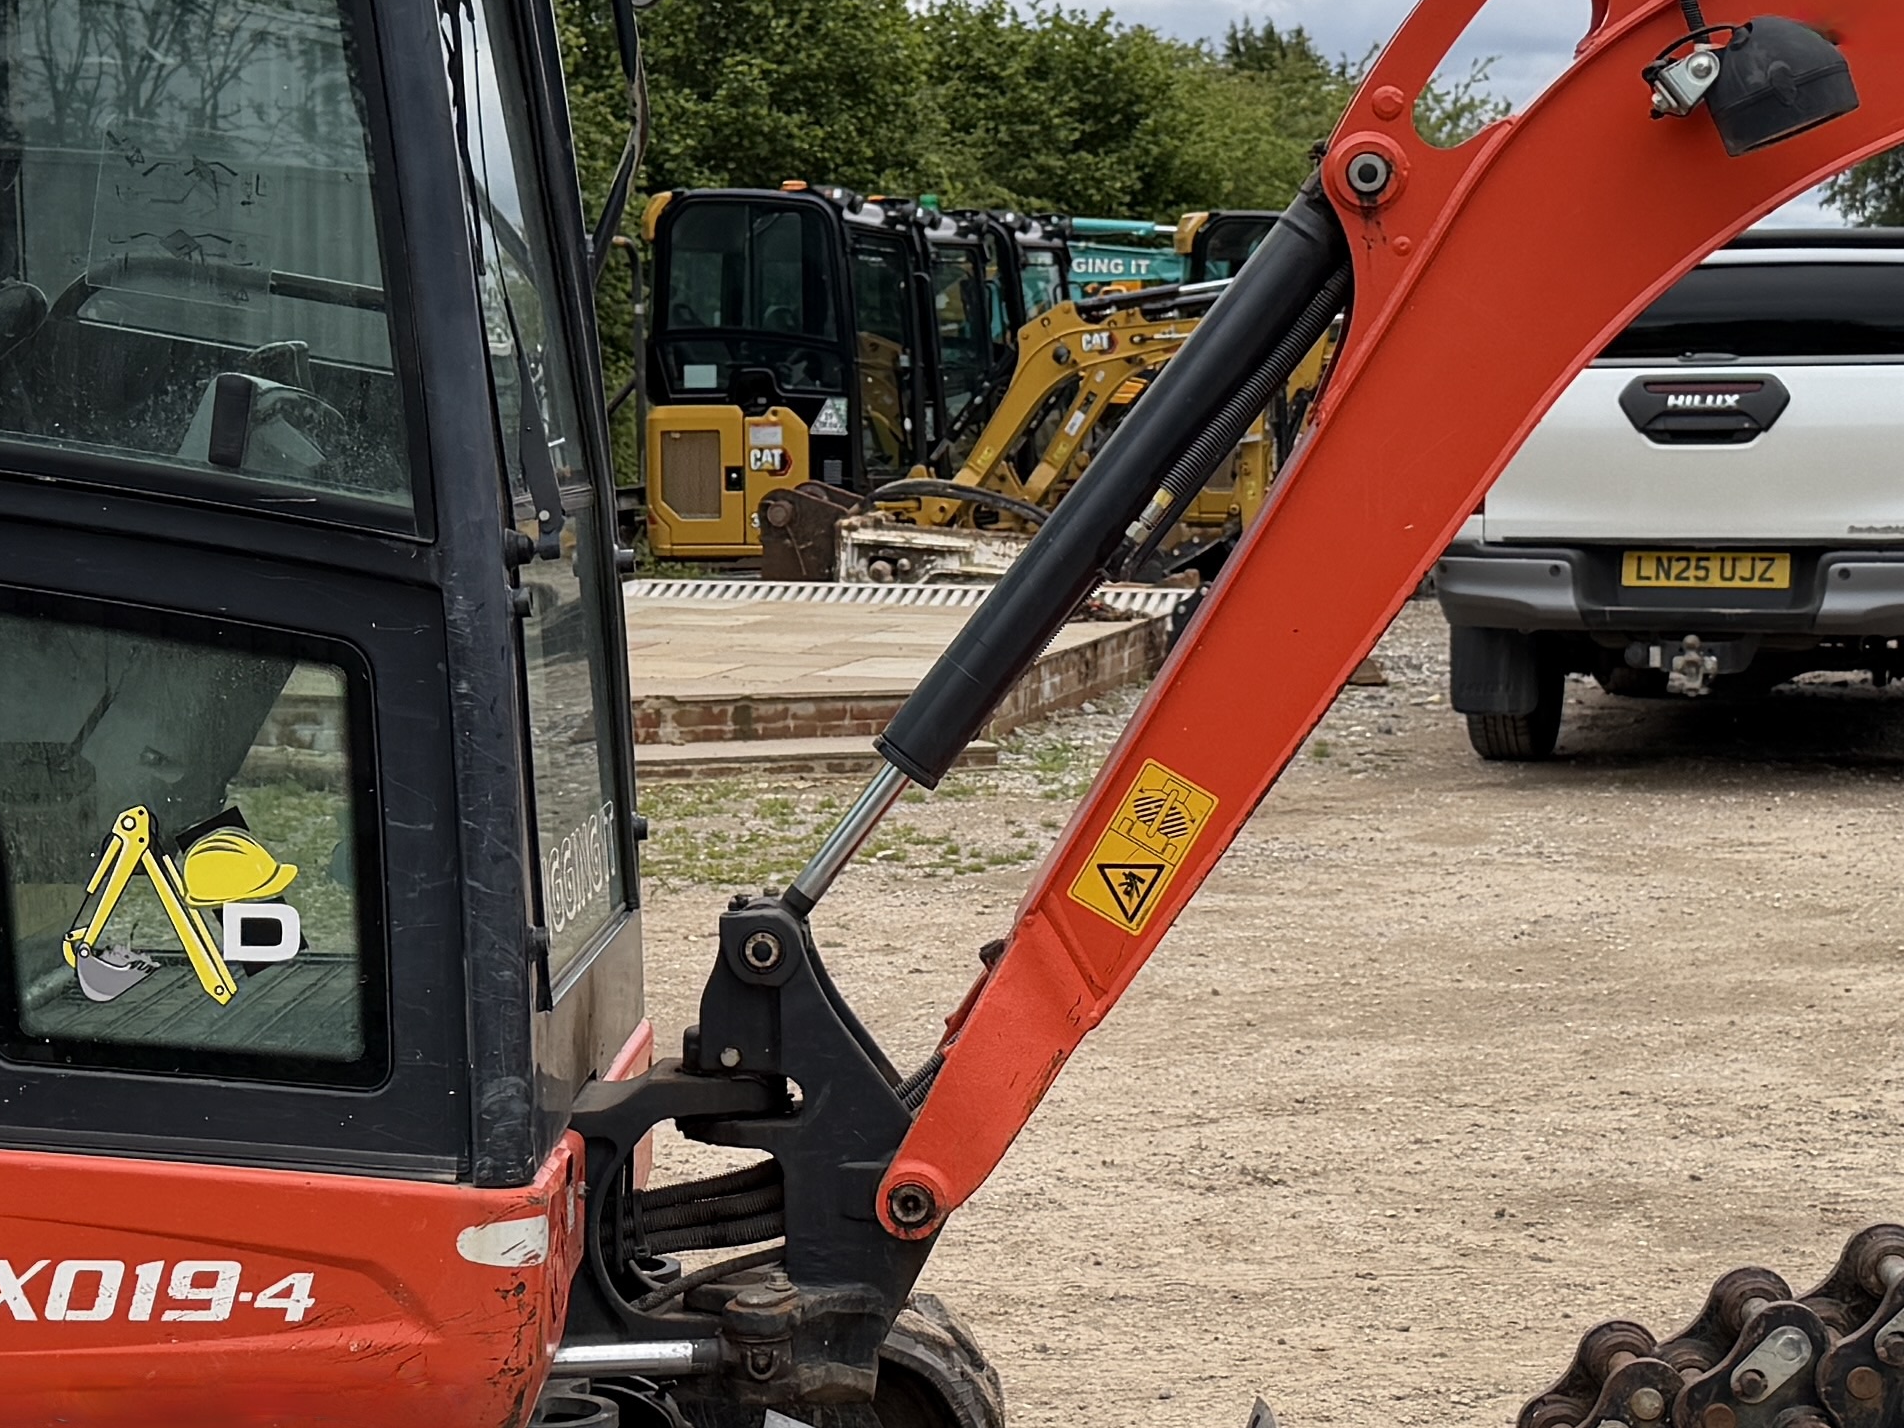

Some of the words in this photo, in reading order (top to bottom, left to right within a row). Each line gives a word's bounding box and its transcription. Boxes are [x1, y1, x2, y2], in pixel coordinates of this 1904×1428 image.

[1071, 258, 1124, 274] GING
[1131, 259, 1151, 274] IT
[1081, 332, 1110, 351] CAT
[1666, 394, 1740, 407] HILUX
[750, 448, 783, 470] CAT
[1635, 555, 1710, 582] LN25
[1719, 557, 1776, 582] UJZ
